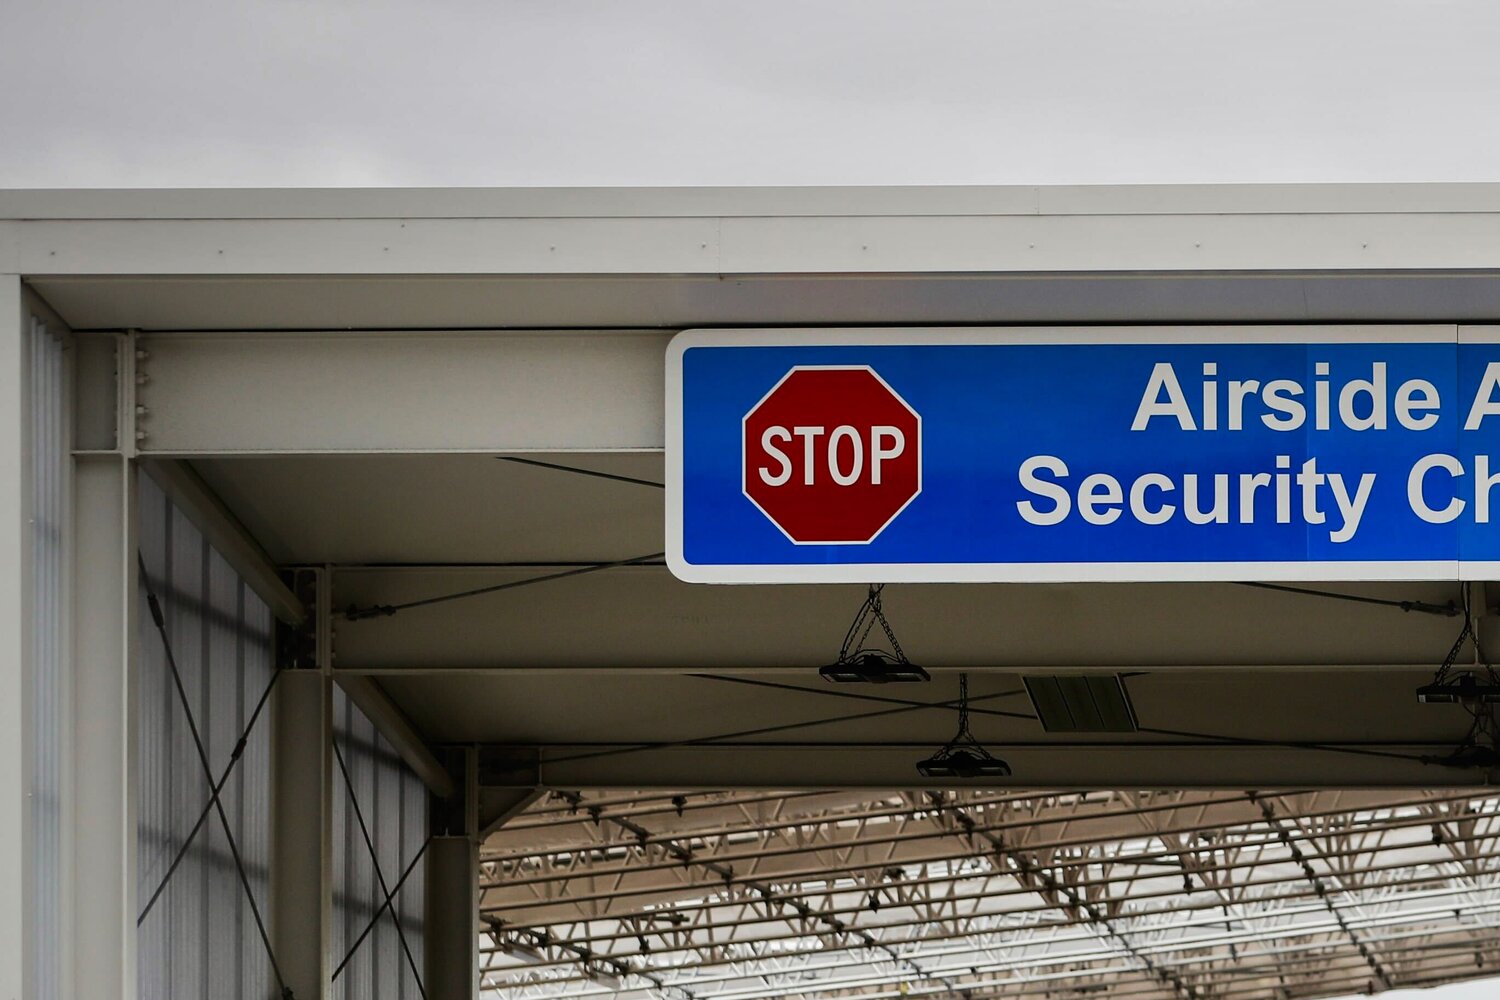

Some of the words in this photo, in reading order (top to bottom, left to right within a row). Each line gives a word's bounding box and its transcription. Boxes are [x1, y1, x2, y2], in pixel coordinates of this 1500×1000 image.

[1131, 362, 1441, 431] Airside
[759, 424, 905, 487] STOP
[1016, 455, 1377, 542] Security
